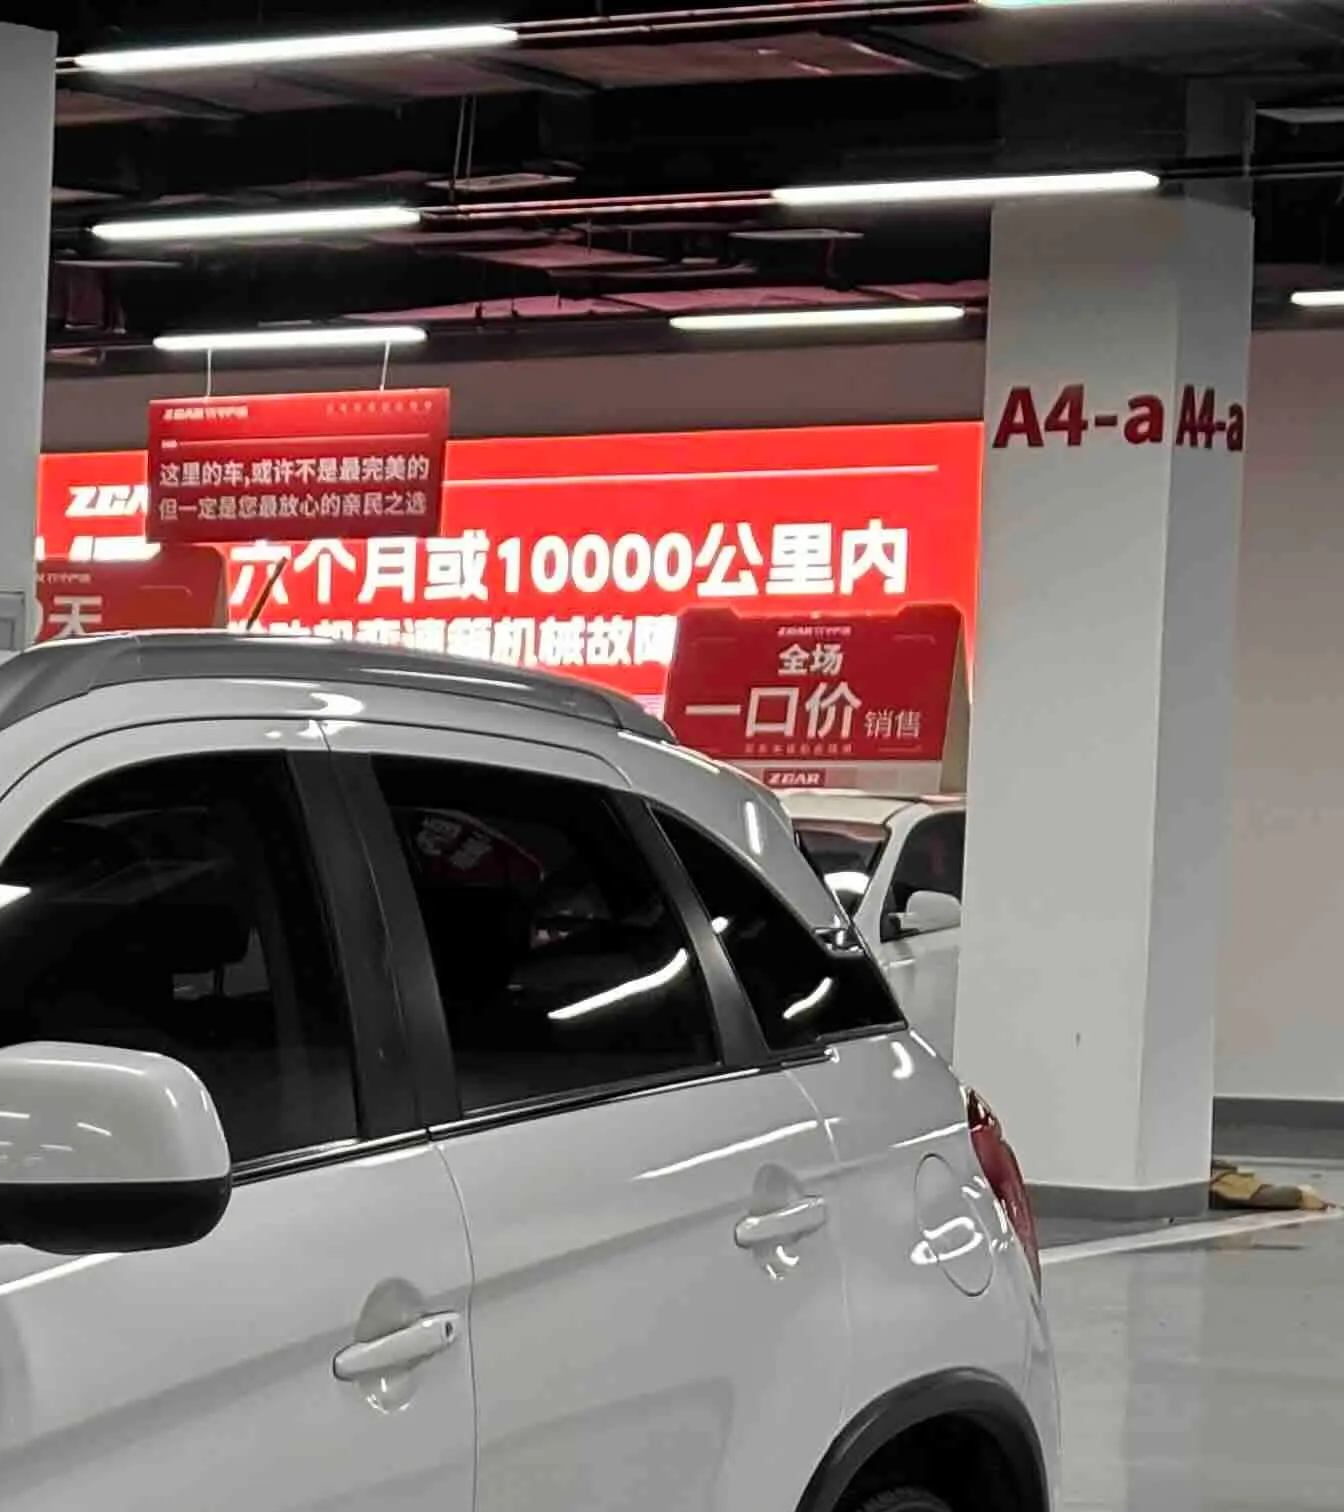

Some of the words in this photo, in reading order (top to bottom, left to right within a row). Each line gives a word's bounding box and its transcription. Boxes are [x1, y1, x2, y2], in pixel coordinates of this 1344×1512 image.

[992, 383, 1165, 449] A4-a
[1175, 383, 1244, 452] A4-a
[229, 518, 909, 605] 六个月或10000公里内
[778, 643, 843, 676] 全场
[685, 681, 862, 739] 一口价
[863, 708, 921, 740] 销售
